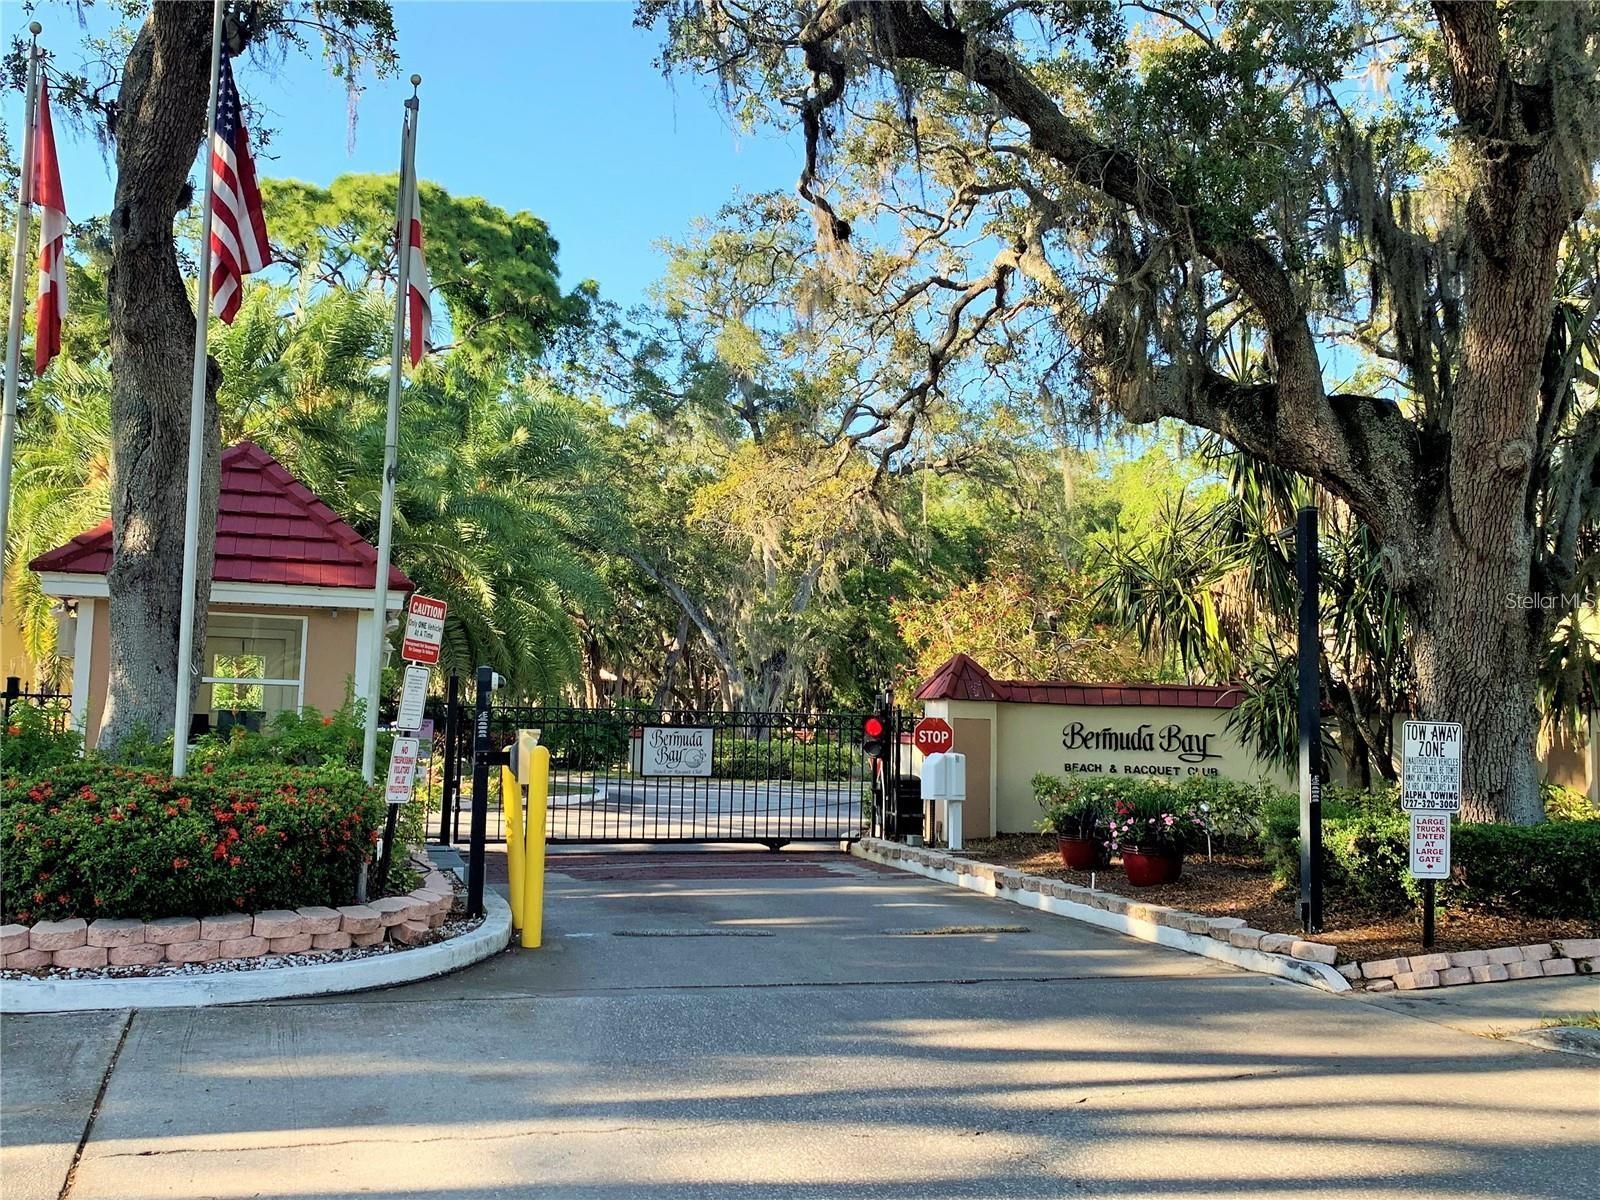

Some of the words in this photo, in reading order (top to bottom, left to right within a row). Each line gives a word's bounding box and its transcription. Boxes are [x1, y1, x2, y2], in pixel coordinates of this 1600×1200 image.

[413, 602, 444, 619] CAUTION
[418, 620, 428, 630] ONE
[650, 729, 703, 748] Bermuda
[919, 730, 949, 743] STOP
[1407, 724, 1426, 741] TOW
[1431, 726, 1458, 742] AWAY
[1062, 721, 1154, 752] Bermuda
[1159, 724, 1223, 763] Bay
[401, 746, 409, 754] NO
[1419, 741, 1445, 758] ZONE
[655, 746, 687, 769] Bay
[1064, 763, 1102, 773] BEACH
[1109, 764, 1118, 774] &
[1124, 765, 1181, 776] RACQUET
[1405, 790, 1426, 800] ALPHA
[1430, 791, 1458, 801] TOWING
[1405, 800, 1458, 809] 727-320-3004
[1416, 818, 1444, 826] LARGE
[1416, 825, 1446, 833] TRUCKS
